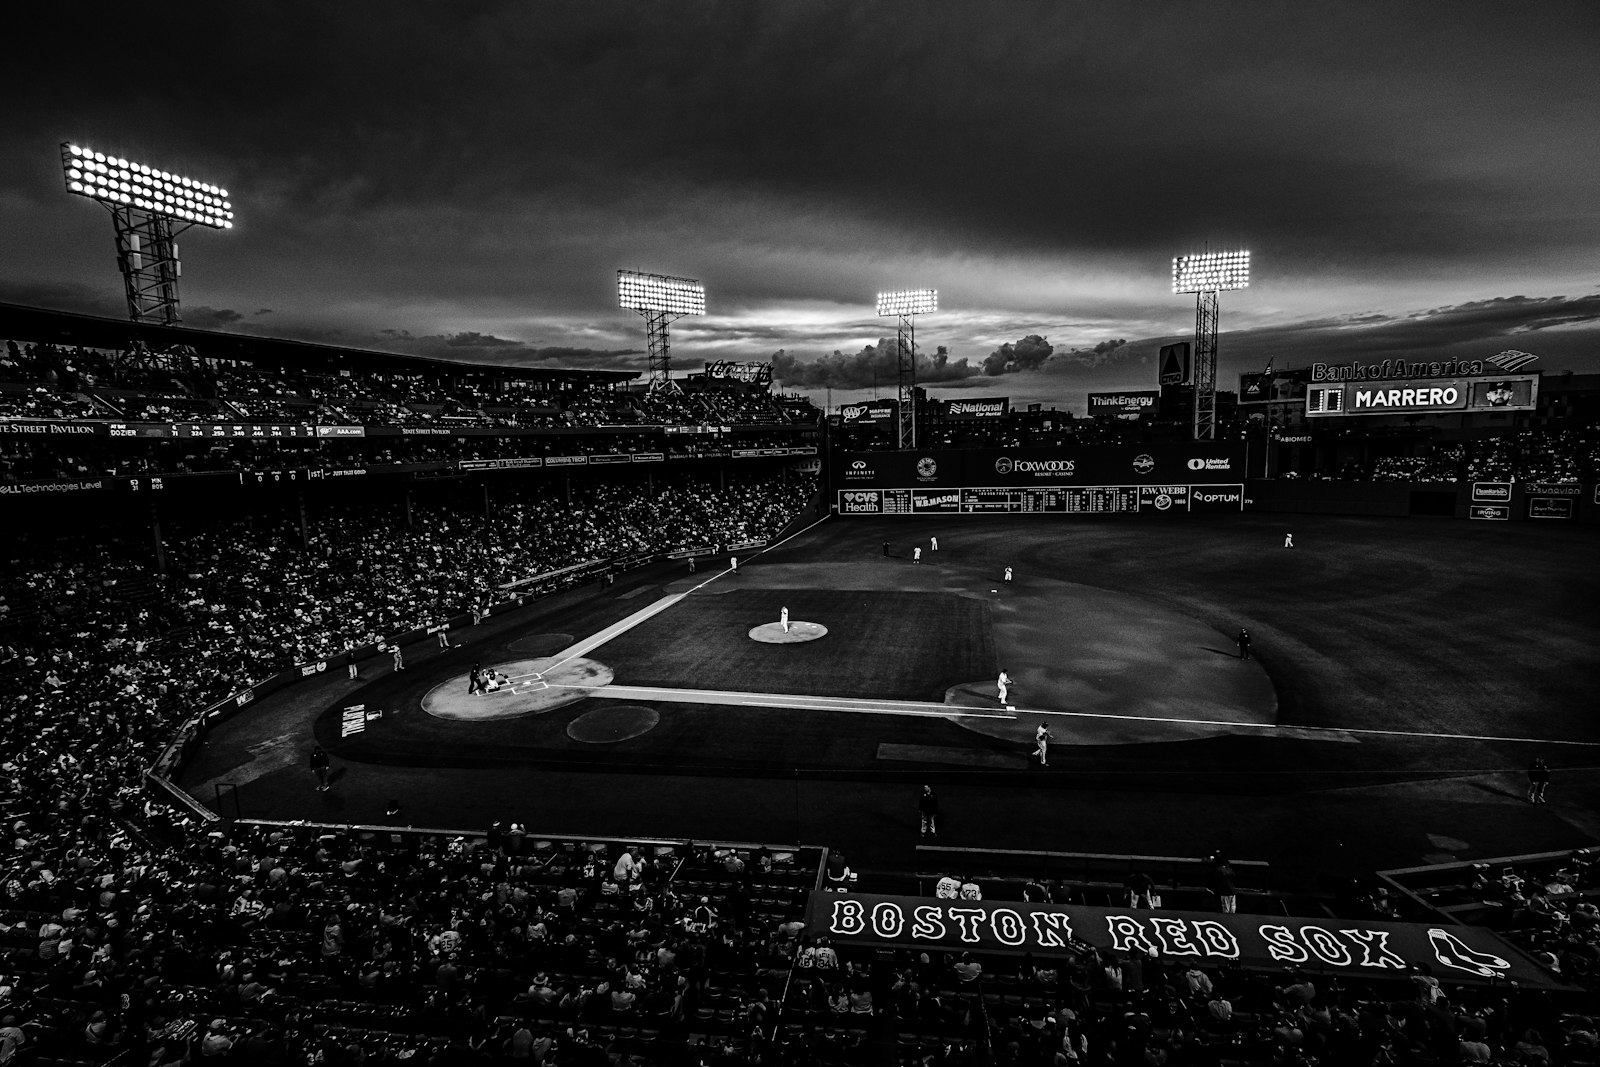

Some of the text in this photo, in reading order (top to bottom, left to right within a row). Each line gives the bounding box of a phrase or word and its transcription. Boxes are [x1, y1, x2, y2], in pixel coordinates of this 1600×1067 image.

[1312, 357, 1483, 382] Bank of America
[1092, 396, 1154, 406] ThinkEnergy
[1356, 388, 1458, 408] MARRERO
[961, 402, 1004, 412] National
[11, 424, 47, 433] STREET
[50, 424, 95, 433] PAVILION
[1280, 435, 1313, 443] ABIOMED
[1014, 459, 1075, 472] FOXWOODS
[20, 483, 79, 493] Technologies
[80, 480, 102, 490] Level
[1142, 486, 1187, 495] F.W. WEBB
[854, 492, 879, 503] CVS
[1203, 494, 1240, 503] OPTUM
[845, 502, 879, 512] Health
[829, 900, 1406, 969] BOSTON RED SOX
